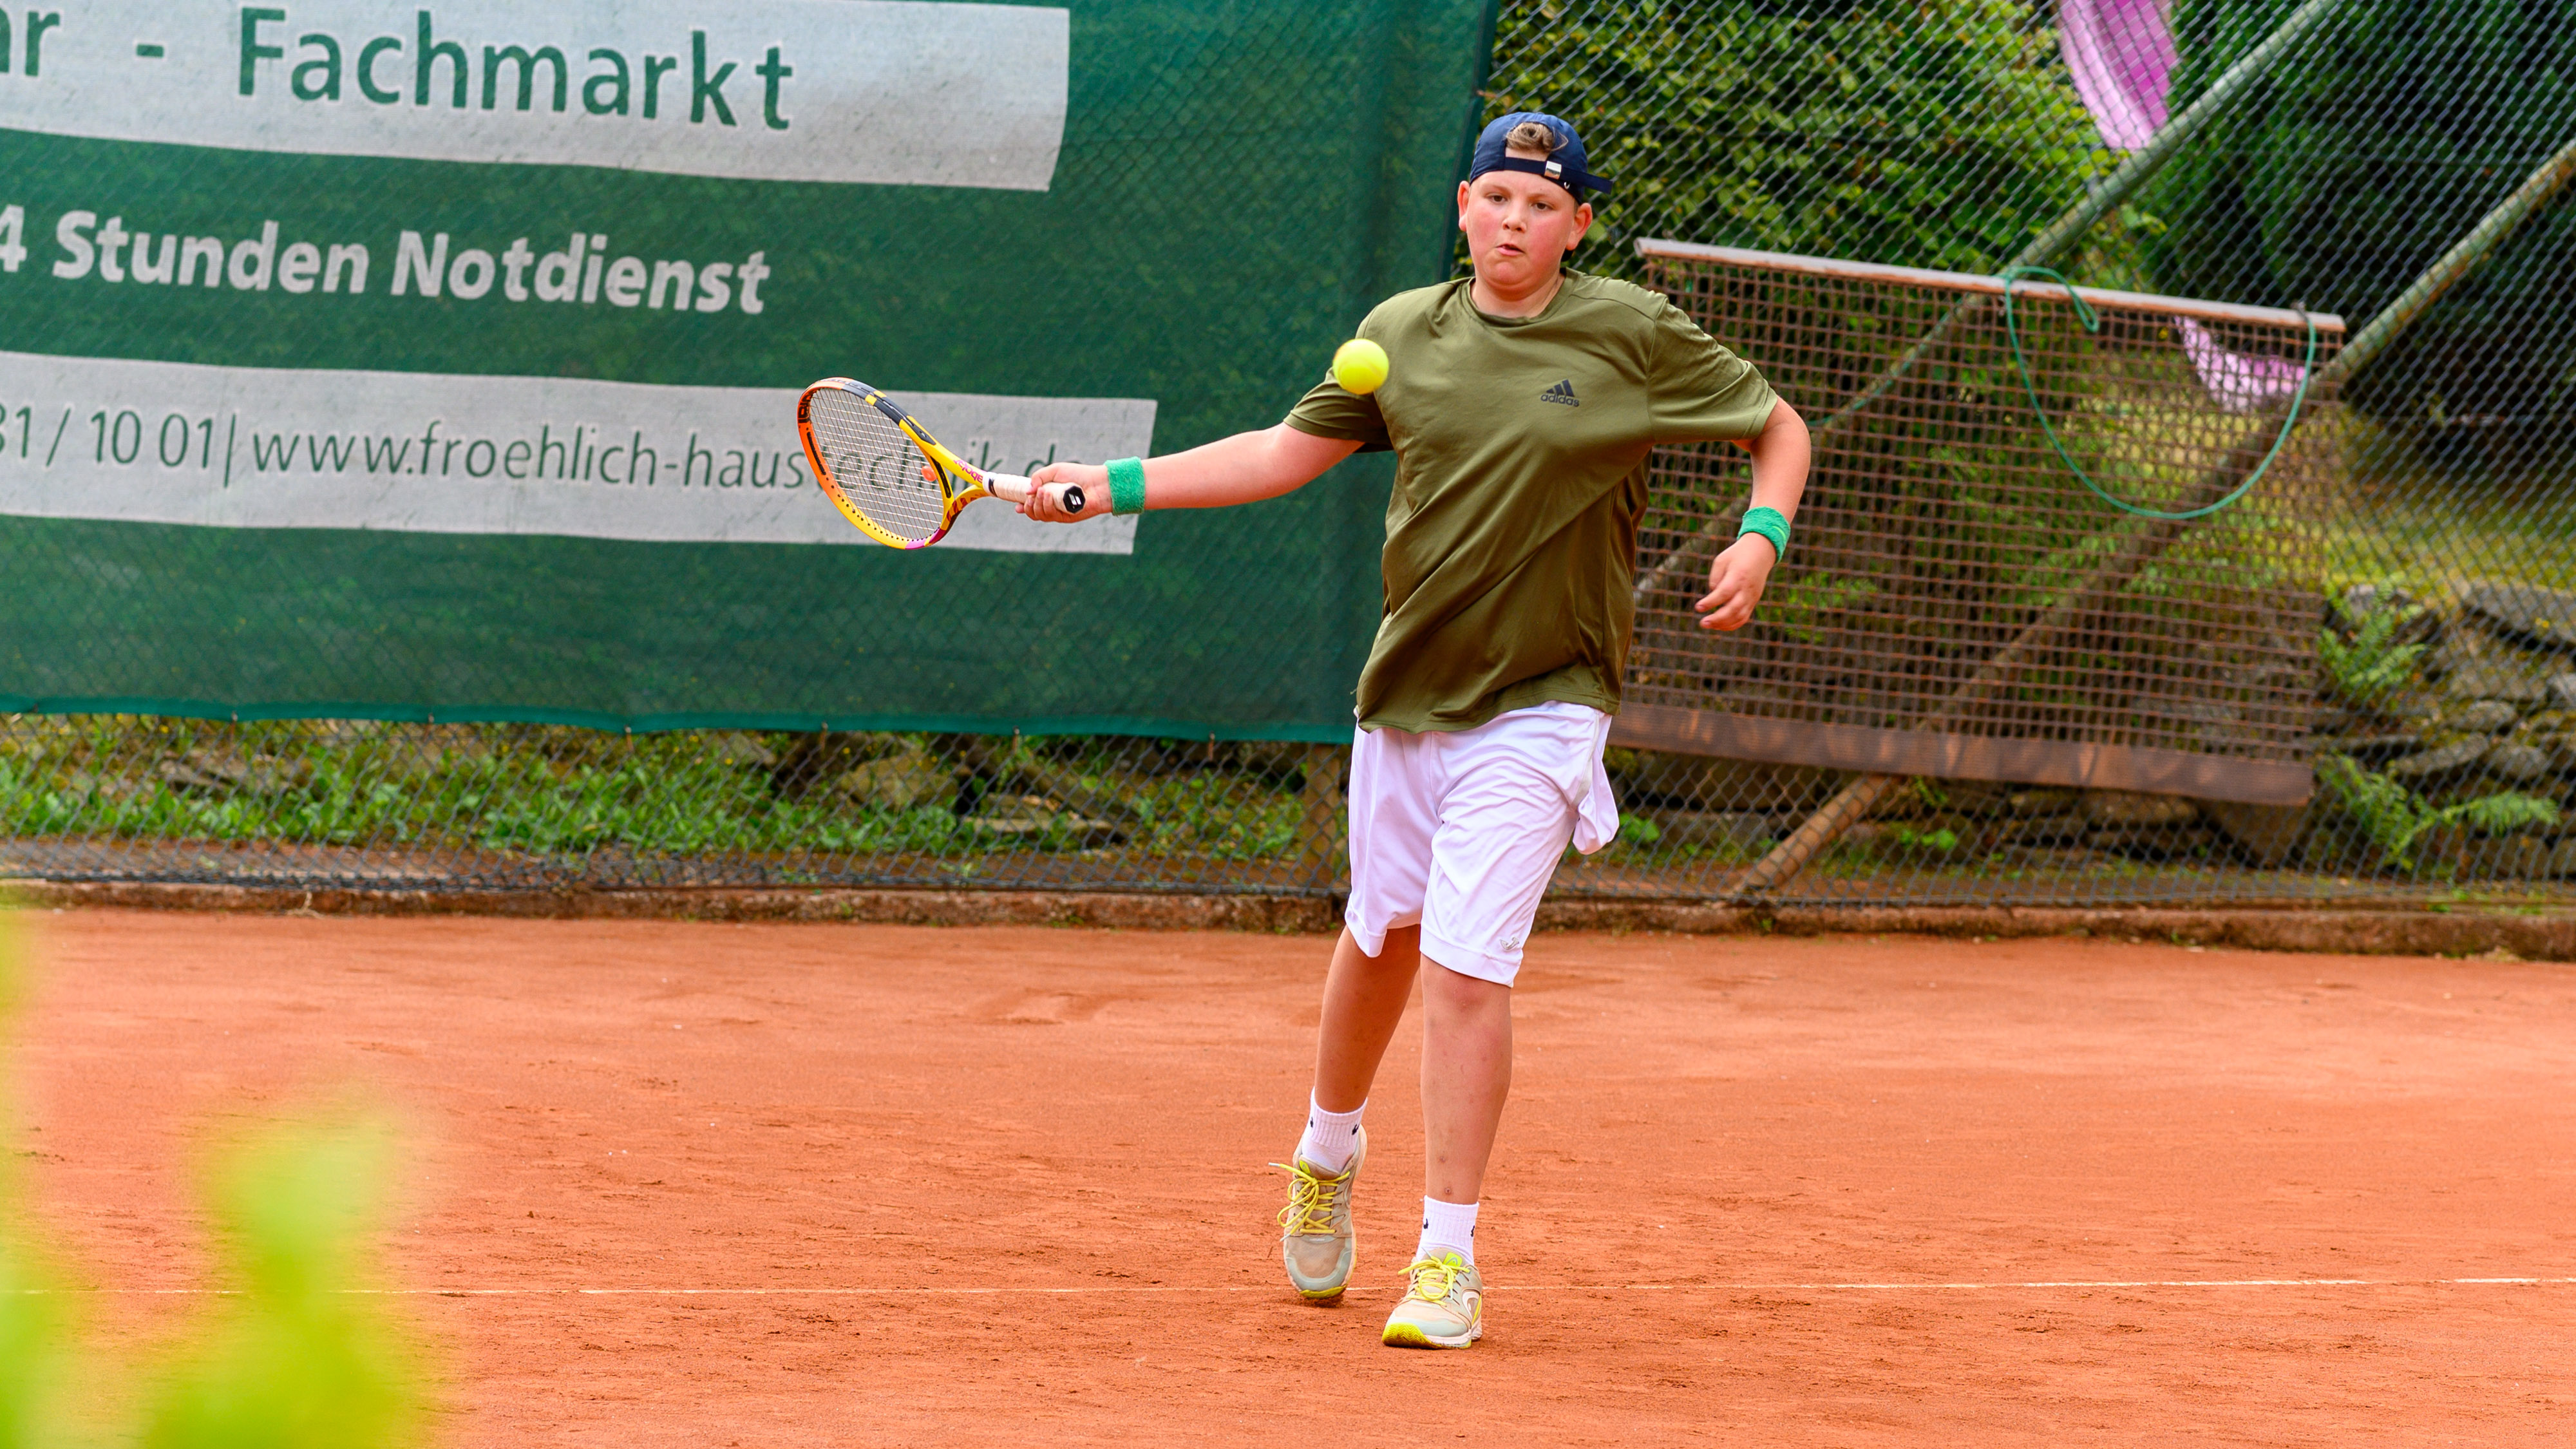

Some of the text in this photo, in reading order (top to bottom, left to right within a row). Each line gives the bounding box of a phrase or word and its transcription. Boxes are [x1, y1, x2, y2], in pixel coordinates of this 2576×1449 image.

[0, 6, 61, 77] r
[238, 6, 793, 129] Fachmarkt
[52, 210, 370, 294] Stunden
[390, 230, 771, 314] Notdienst
[1540, 393, 1580, 407] adidas
